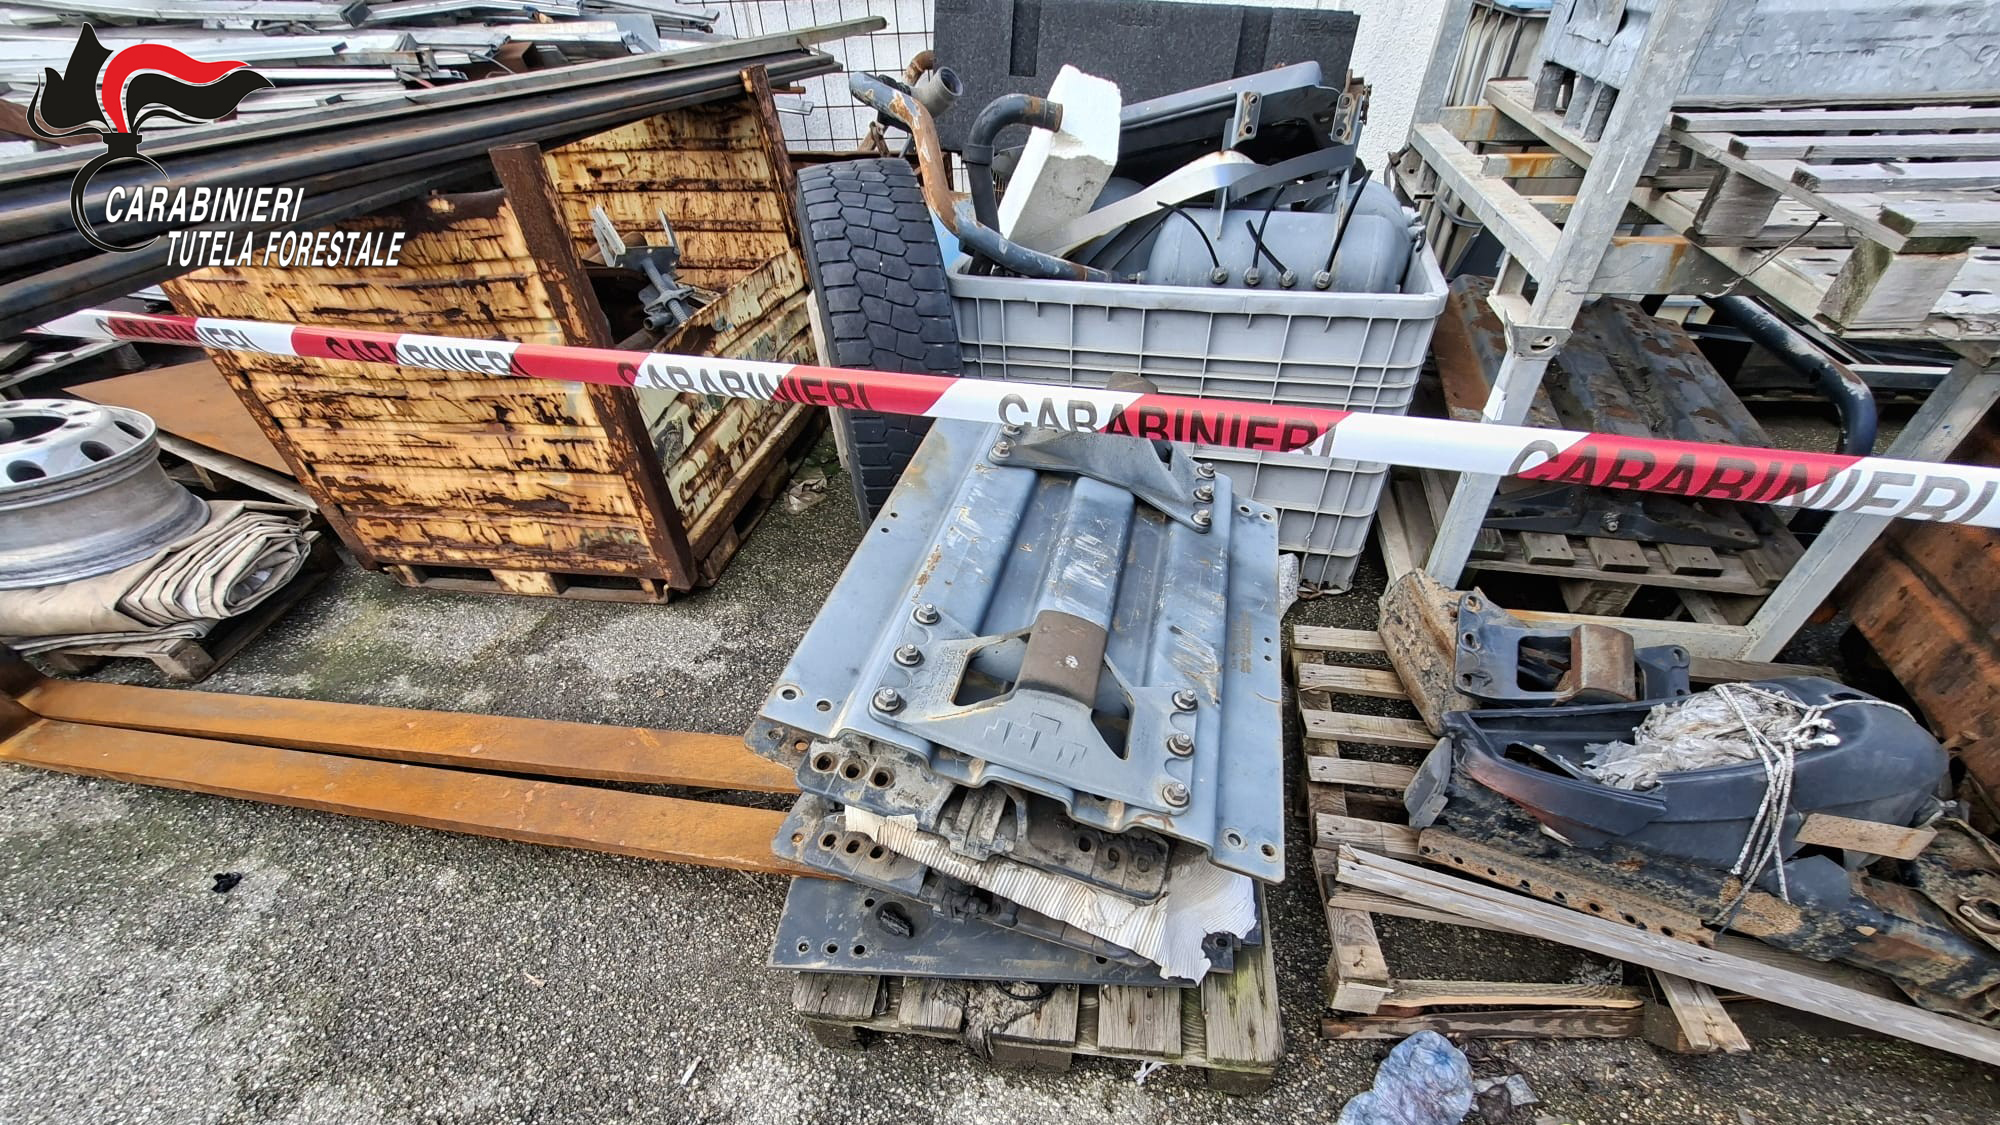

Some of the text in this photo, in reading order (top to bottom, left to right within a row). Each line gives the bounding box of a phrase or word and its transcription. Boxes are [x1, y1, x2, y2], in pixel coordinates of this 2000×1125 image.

[616, 361, 875, 411] CARABINIERI
[997, 393, 1338, 457] CARABINIERI
[1507, 439, 2000, 525] CARABINIERI
